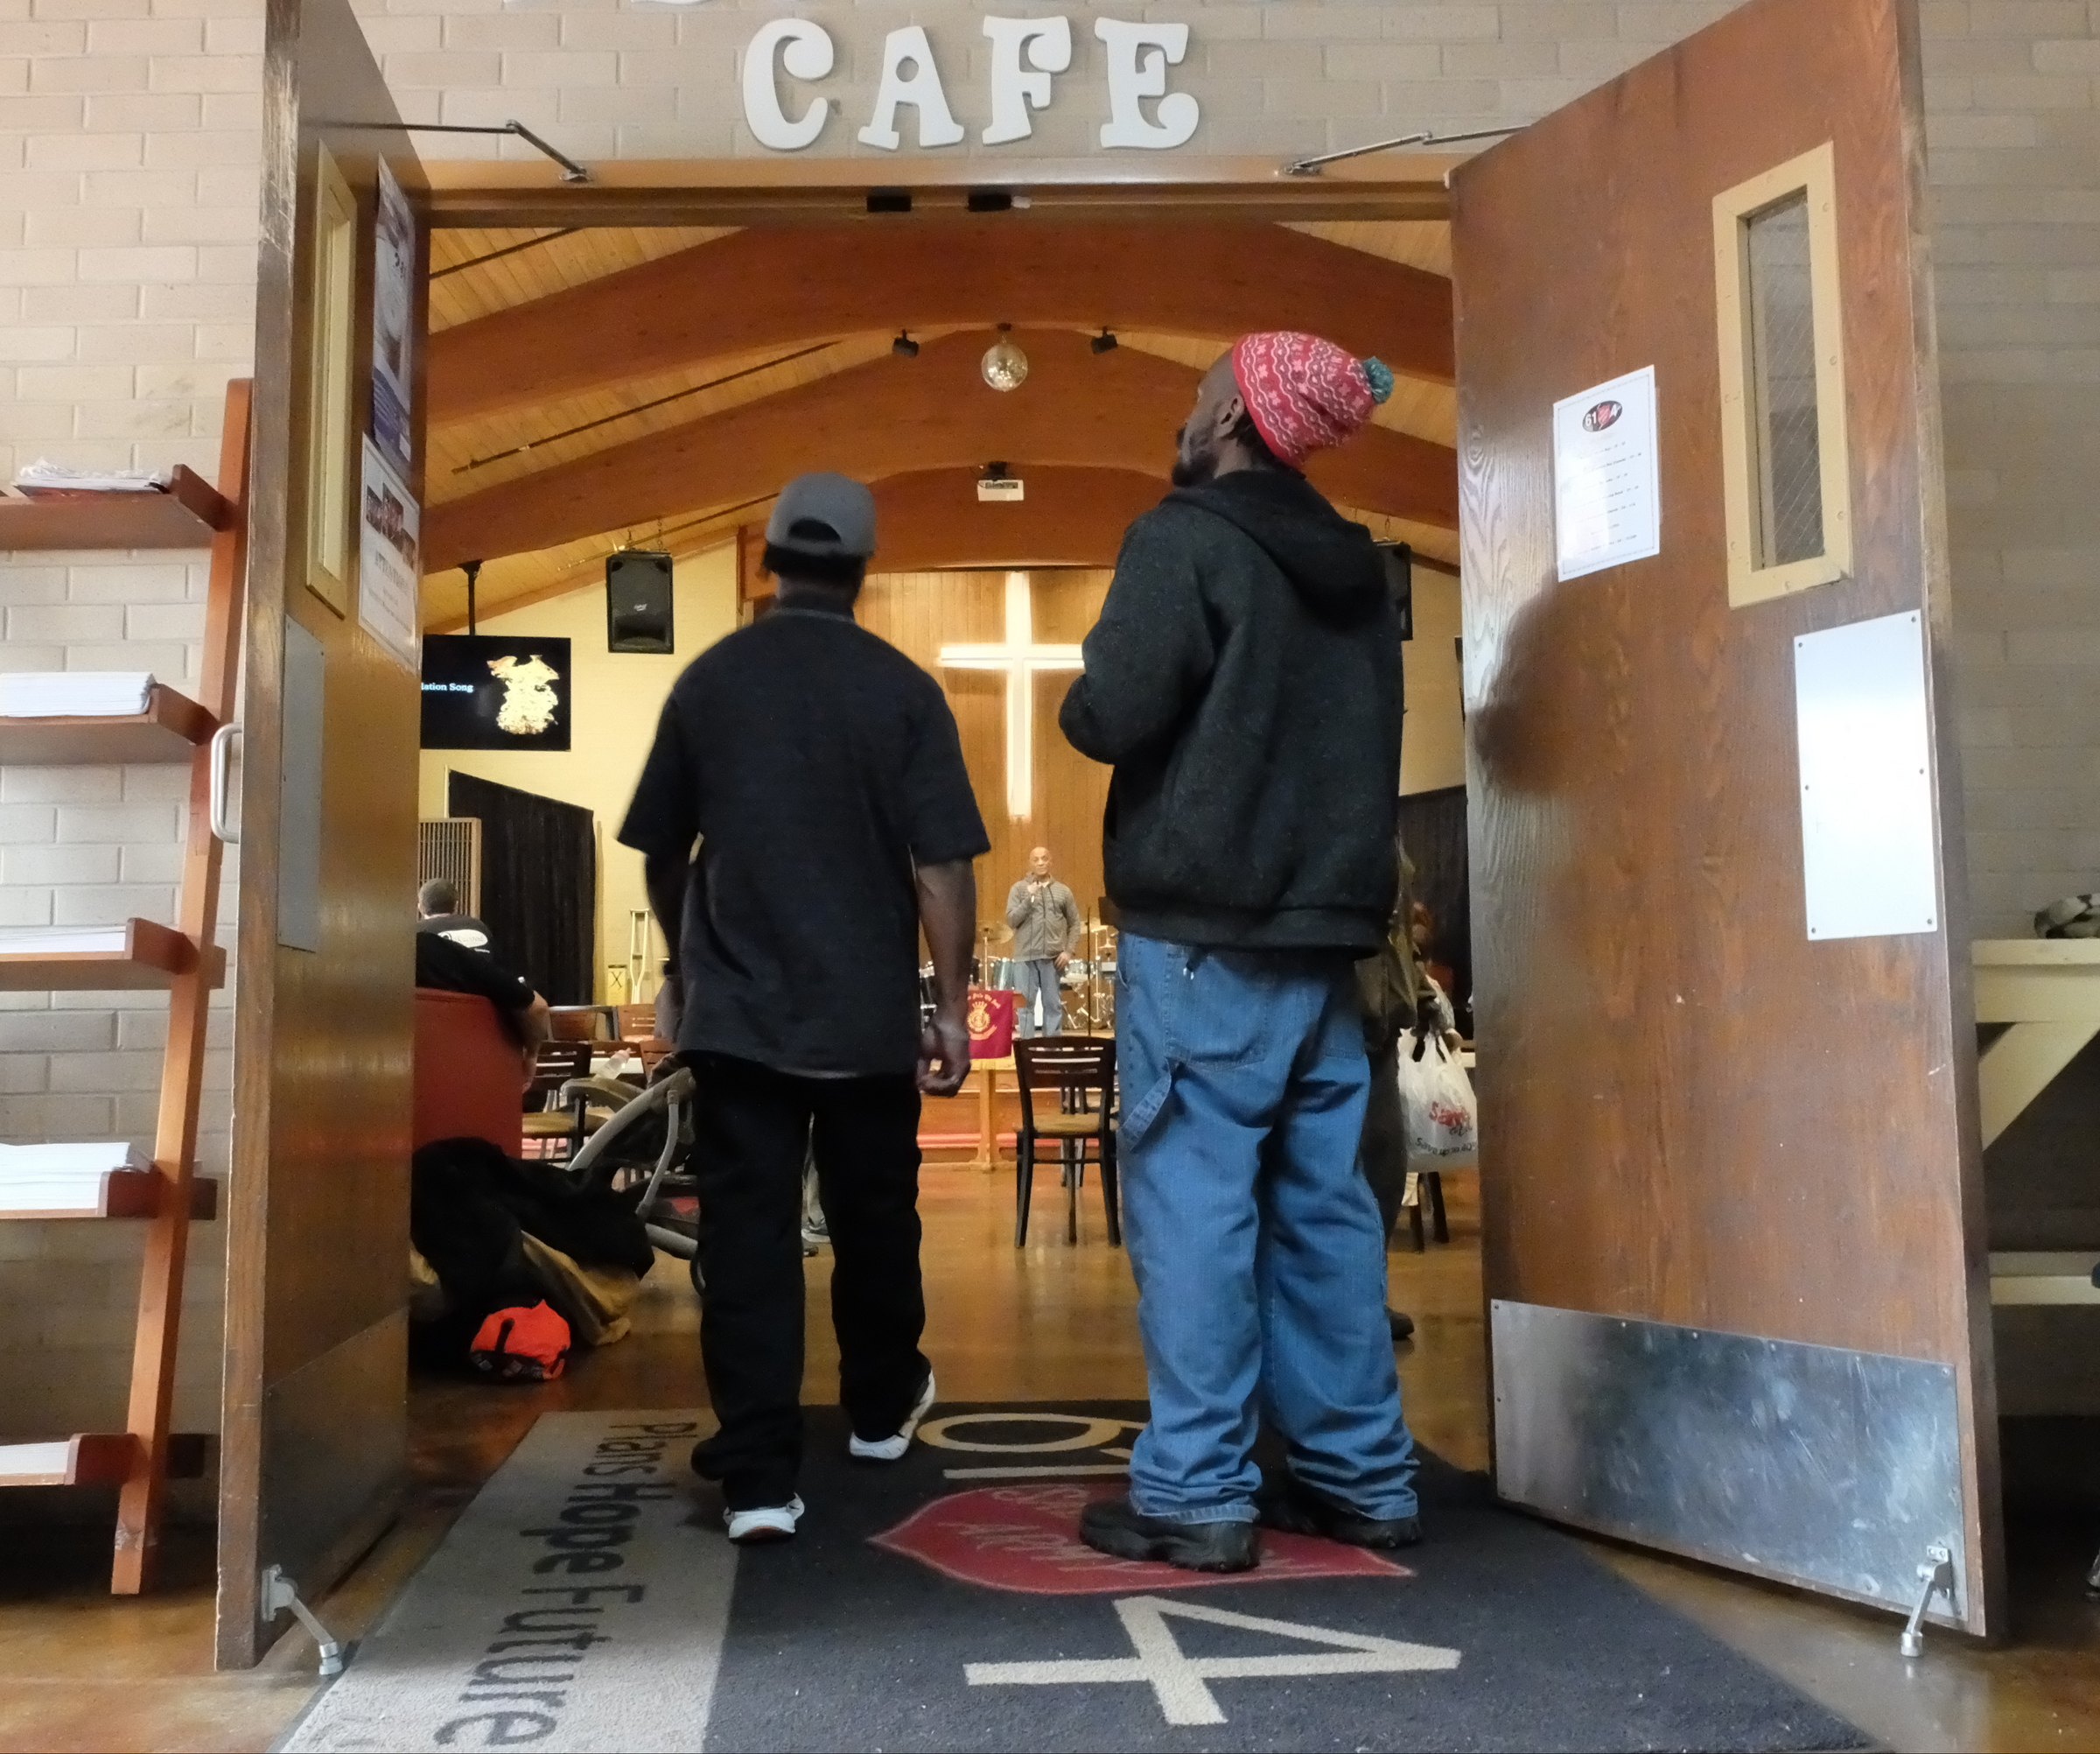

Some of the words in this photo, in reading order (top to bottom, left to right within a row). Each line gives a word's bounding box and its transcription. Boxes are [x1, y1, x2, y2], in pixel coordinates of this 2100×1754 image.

[742, 15, 1200, 151] CAFE
[449, 683, 473, 693] Song
[607, 1421, 698, 1477] Plans
[519, 1481, 674, 1575] Hope
[431, 1583, 645, 1747] Future
[962, 1595, 1462, 1727] 4
